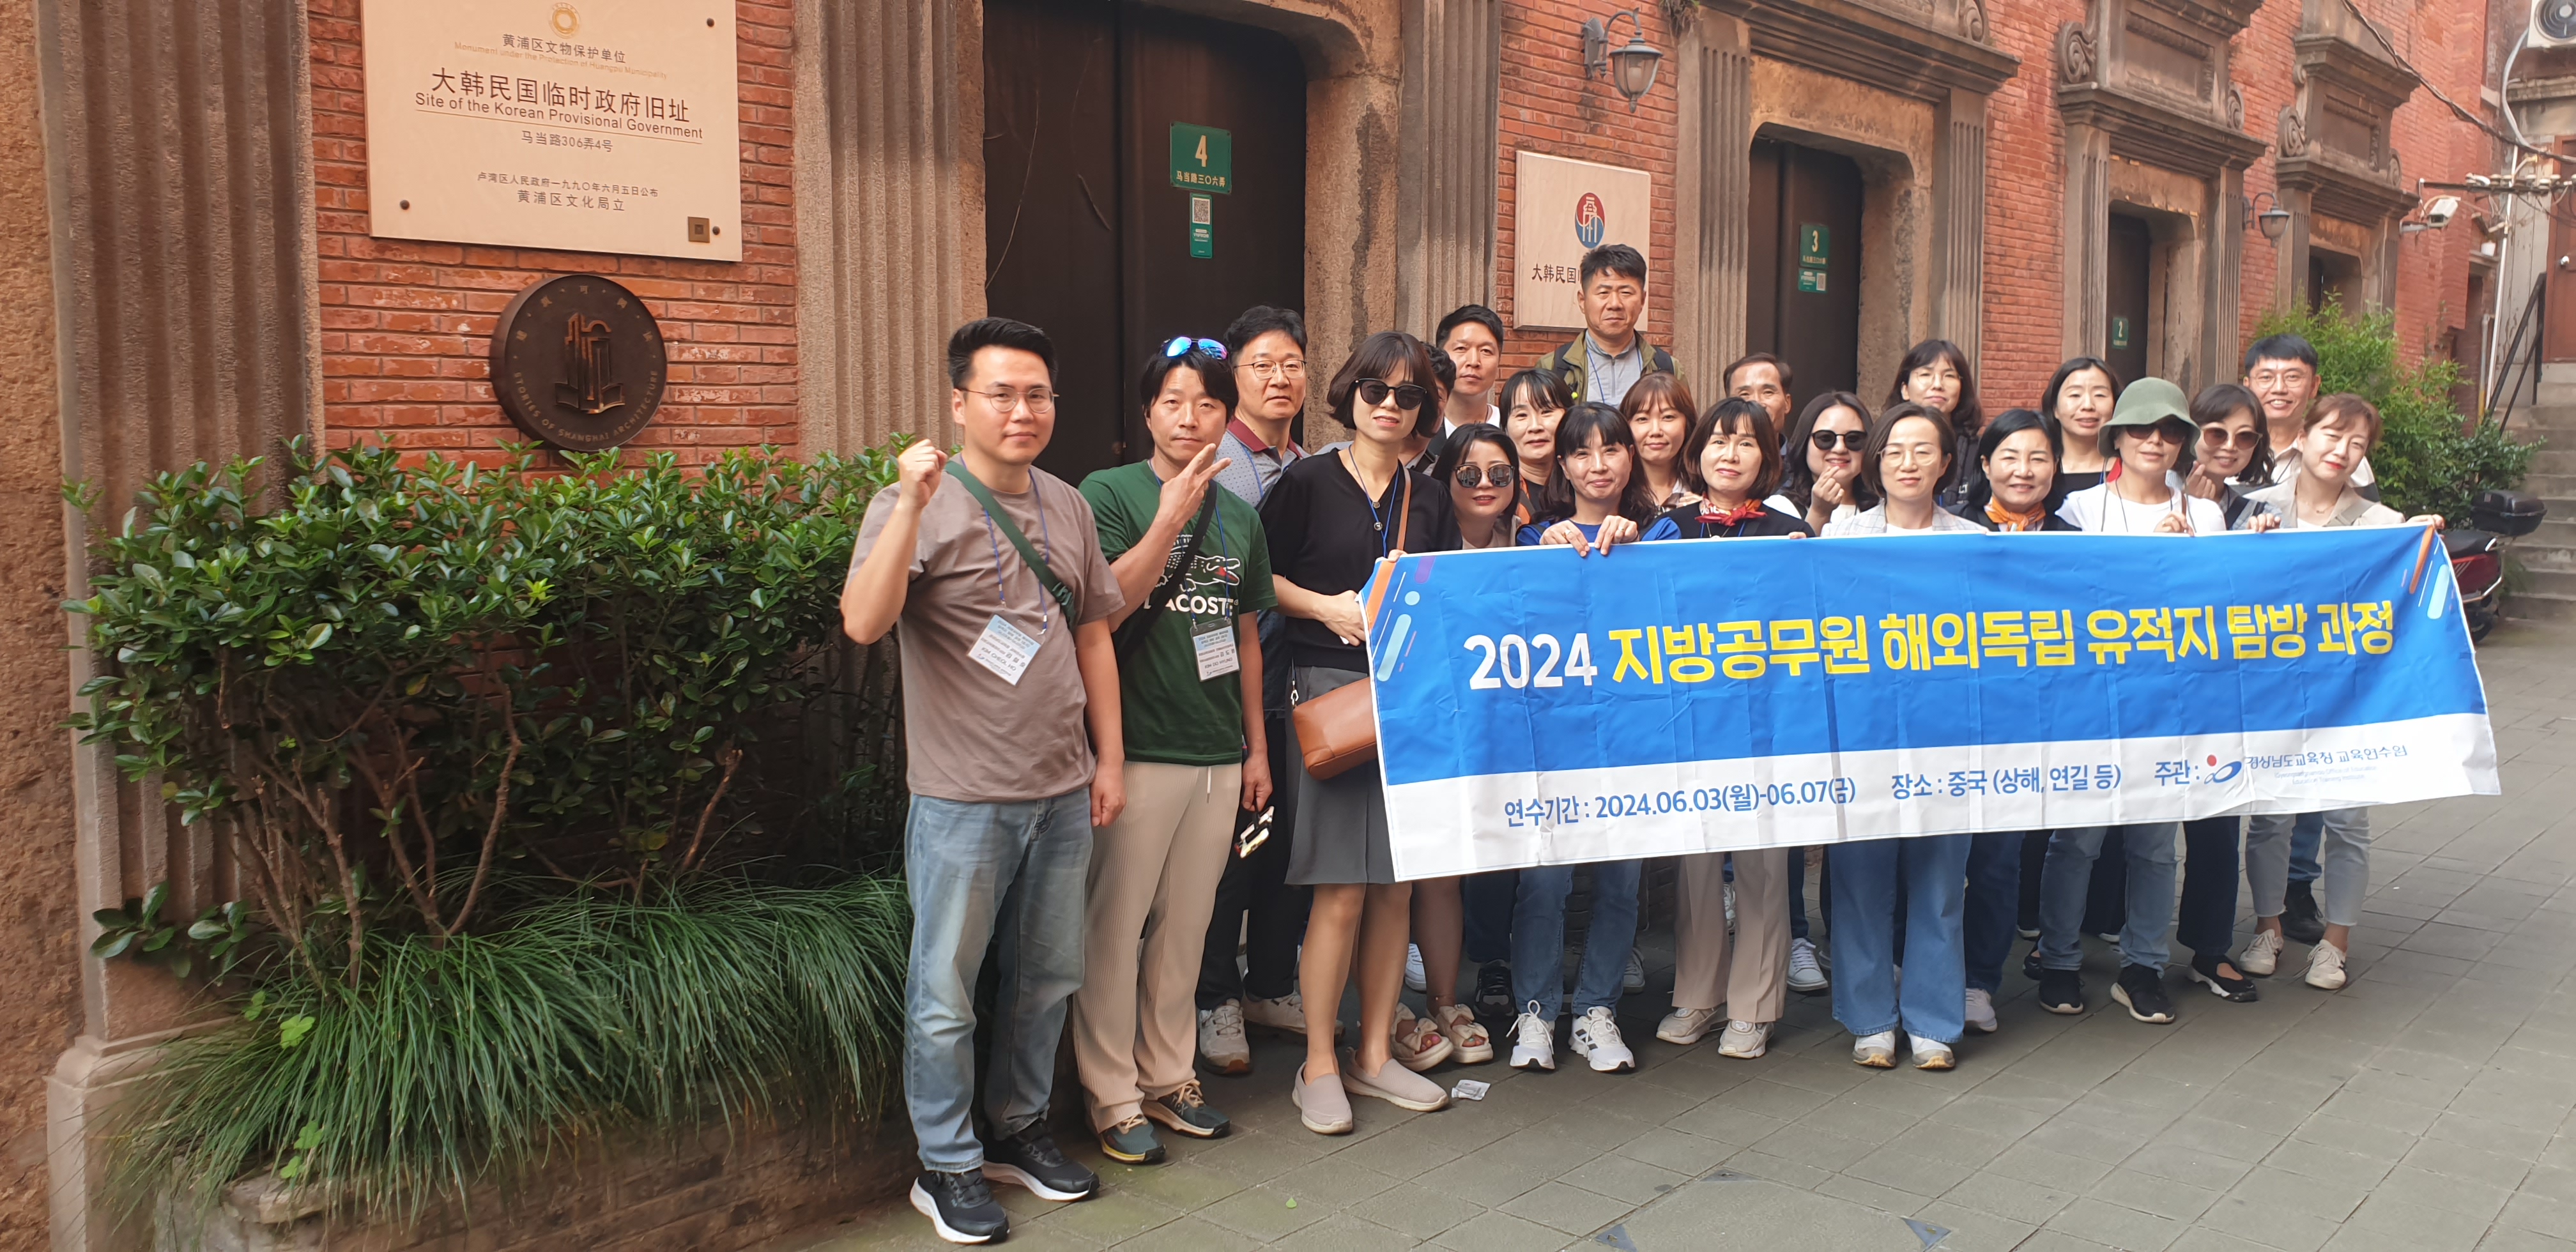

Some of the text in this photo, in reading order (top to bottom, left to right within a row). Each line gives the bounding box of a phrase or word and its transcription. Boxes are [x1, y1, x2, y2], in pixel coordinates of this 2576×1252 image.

[455, 42, 498, 55] Monument
[500, 50, 523, 59] under
[525, 51, 537, 60] the
[502, 34, 626, 63] 黄浦区文物保护单位
[431, 67, 689, 123] 大韩民国临时政府旧址
[415, 92, 703, 139] Site of the Korean Provisional Government
[521, 130, 613, 153] 马当路306弄4号
[1195, 135, 1208, 167] 4
[518, 190, 625, 211] 黄浦区文化局立
[1812, 230, 1819, 252] 3
[1531, 263, 1580, 284] 大韩民国
[2119, 321, 2123, 338] 2
[542, 418, 555, 429] OF
[558, 429, 610, 442] SHANGHAI
[613, 370, 657, 436] ARCHITECTURE
[1464, 600, 2393, 690] 2024 지방공무원 해외독립 유적지 탐방 과정
[2338, 745, 2408, 763] 교육연수원
[1504, 797, 1579, 827] 연수기간
[1596, 777, 1856, 818] 2024.06.03(월)-06.07(금)
[1892, 774, 1933, 800] 장소
[1947, 770, 1988, 797] 중국
[2049, 765, 2089, 791] 연길
[2094, 764, 2121, 790] 등)
[2154, 760, 2190, 786] 주관
